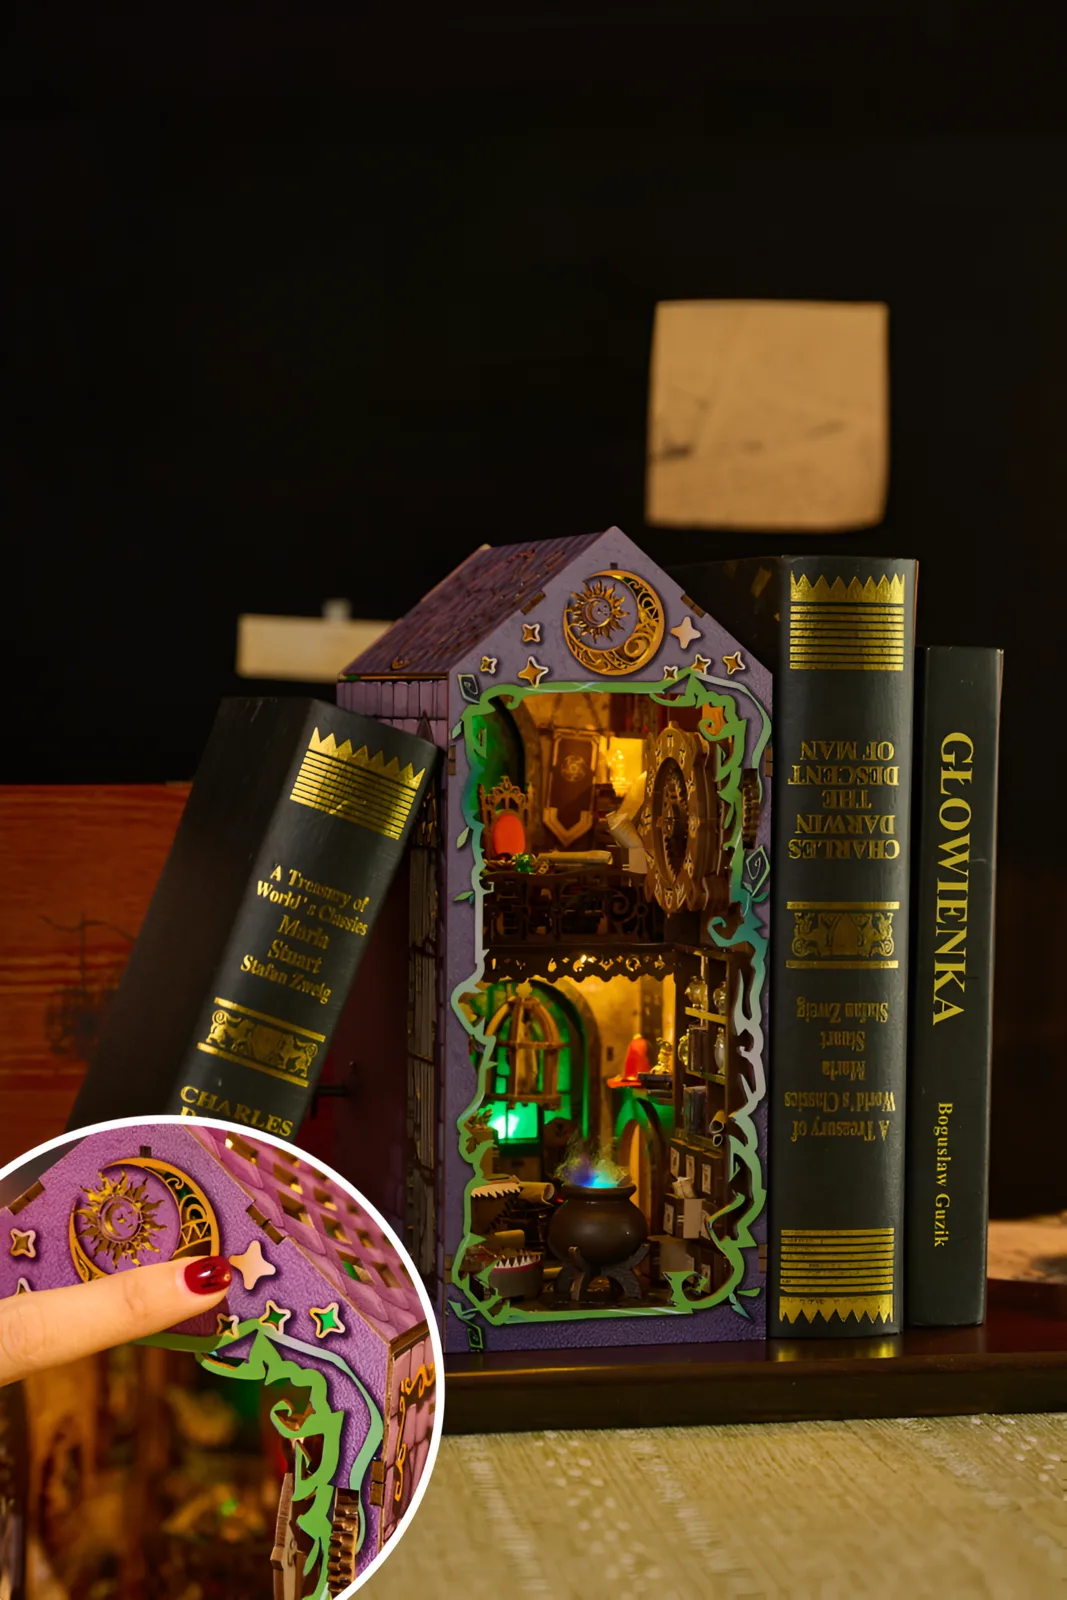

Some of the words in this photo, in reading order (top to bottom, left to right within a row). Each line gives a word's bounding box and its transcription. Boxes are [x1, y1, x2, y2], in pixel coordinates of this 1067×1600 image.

[800, 740, 859, 762] MAN
[863, 740, 895, 762] OF
[787, 764, 900, 786] DESCENT
[821, 789, 872, 809] THE
[795, 814, 896, 835] DARWIN
[787, 838, 901, 861] CHARLES
[270, 863, 282, 882] A
[352, 896, 371, 913] of
[931, 731, 975, 1026] GŁOWIENKA
[317, 905, 369, 936] Classics
[267, 940, 324, 975] Stuart
[288, 972, 333, 1005] Zweig
[796, 996, 841, 1024] Zweig
[820, 1030, 866, 1052] Stuart
[180, 1085, 294, 1137] CHARLES
[784, 1091, 839, 1113] Classics
[790, 1119, 807, 1143] of
[811, 1116, 876, 1142] Treasury
[878, 1119, 890, 1142] A
[933, 1193, 951, 1248] Guzik
